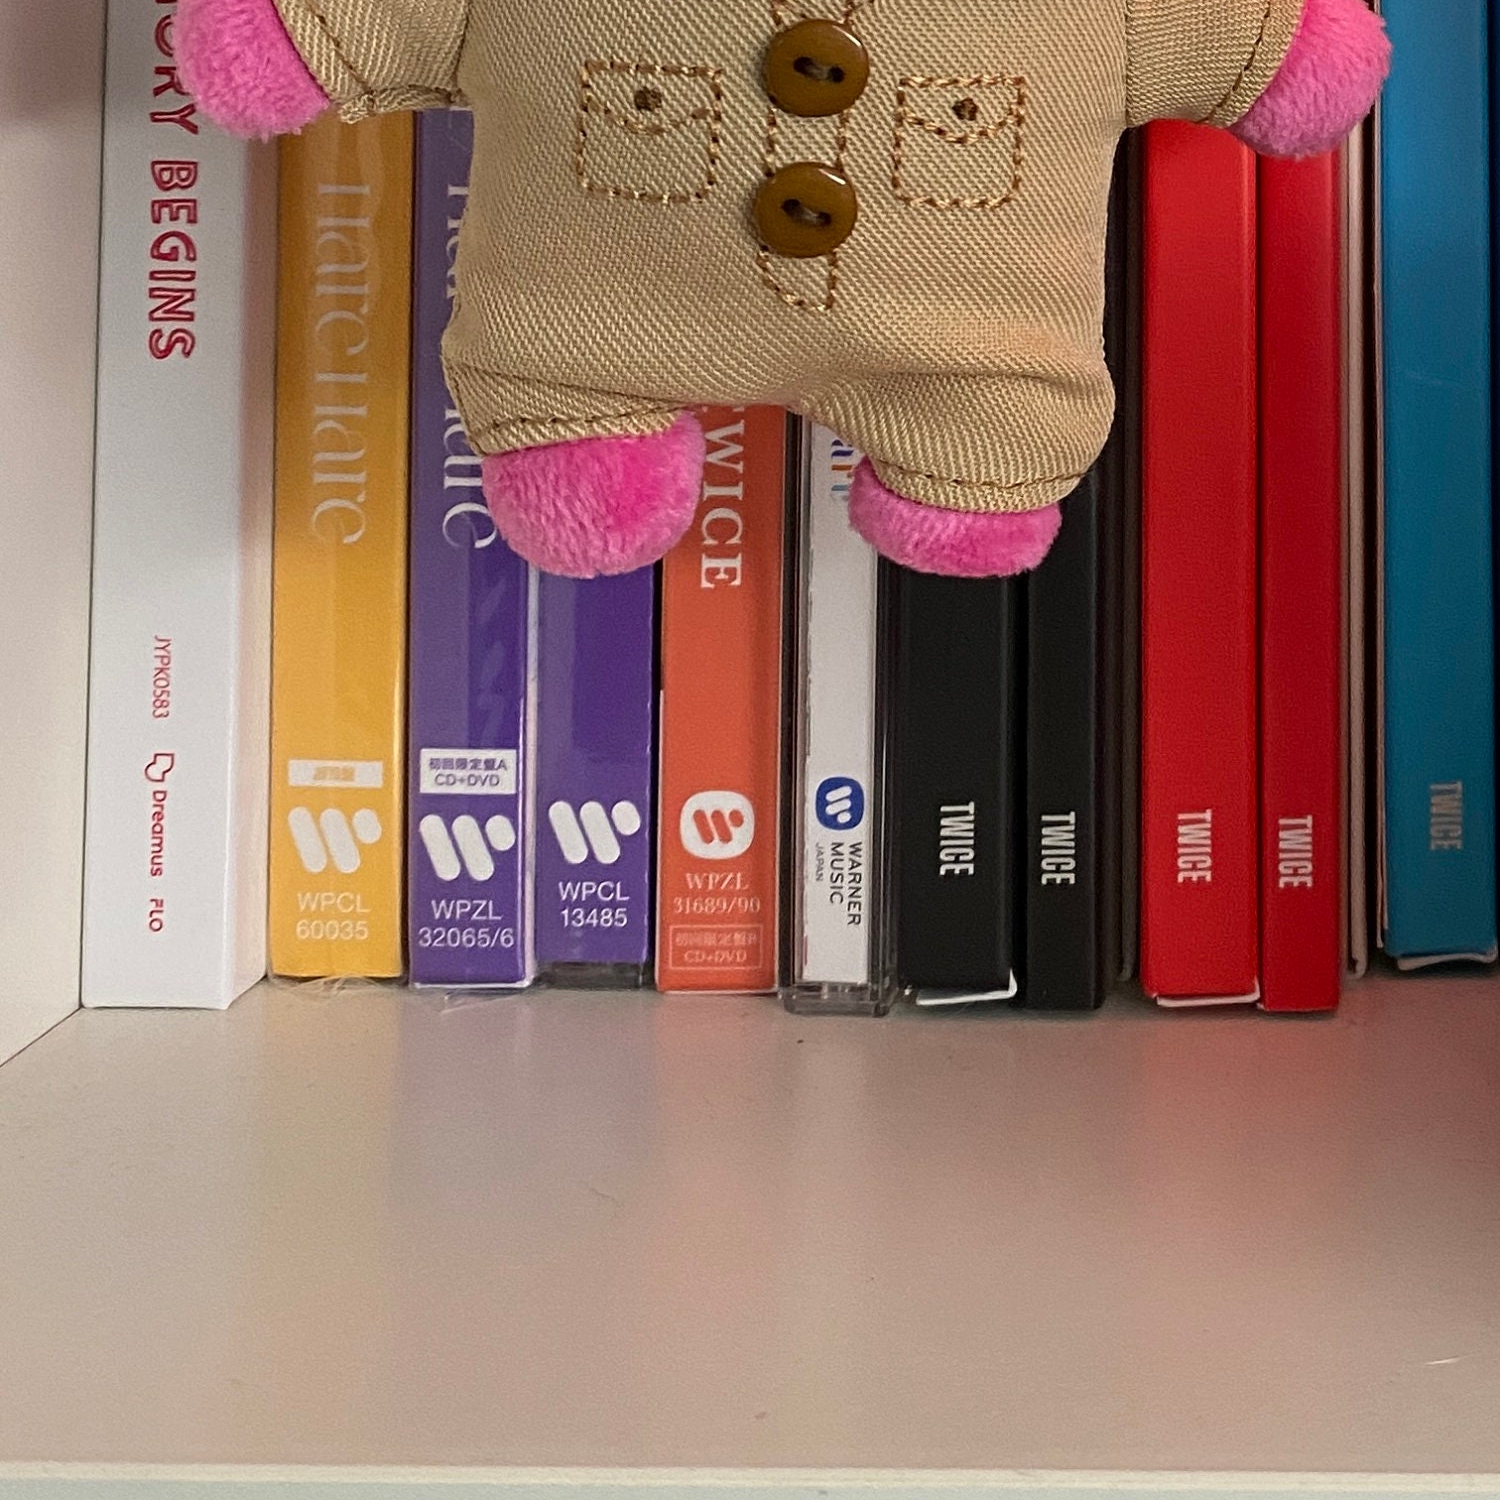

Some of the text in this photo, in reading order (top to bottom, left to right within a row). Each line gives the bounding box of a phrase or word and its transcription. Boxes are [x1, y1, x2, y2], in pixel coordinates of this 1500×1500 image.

[148, 160, 199, 361] BEGINS
[700, 407, 746, 588] WICE
[152, 634, 171, 719] JYPK0583
[434, 773, 501, 787] CD+DVD
[150, 790, 168, 877] Dreamus
[939, 801, 975, 877] TWICE
[1430, 781, 1463, 851] TWICE
[815, 843, 825, 882] JAPAN
[1041, 810, 1076, 886] TWICE
[1177, 809, 1212, 883] TWICE
[1278, 814, 1312, 888] TWICE
[558, 881, 630, 902] WPCL
[685, 873, 749, 890] WPZL
[829, 842, 845, 904] MUSIC
[847, 842, 862, 927] WARNER
[149, 898, 164, 933] FLO
[297, 891, 371, 913] WPCL
[431, 900, 503, 920] WPZL
[560, 906, 628, 928] 13485
[674, 897, 761, 914] 31689/90
[296, 919, 369, 940] 60035
[418, 927, 515, 948] 32065/6
